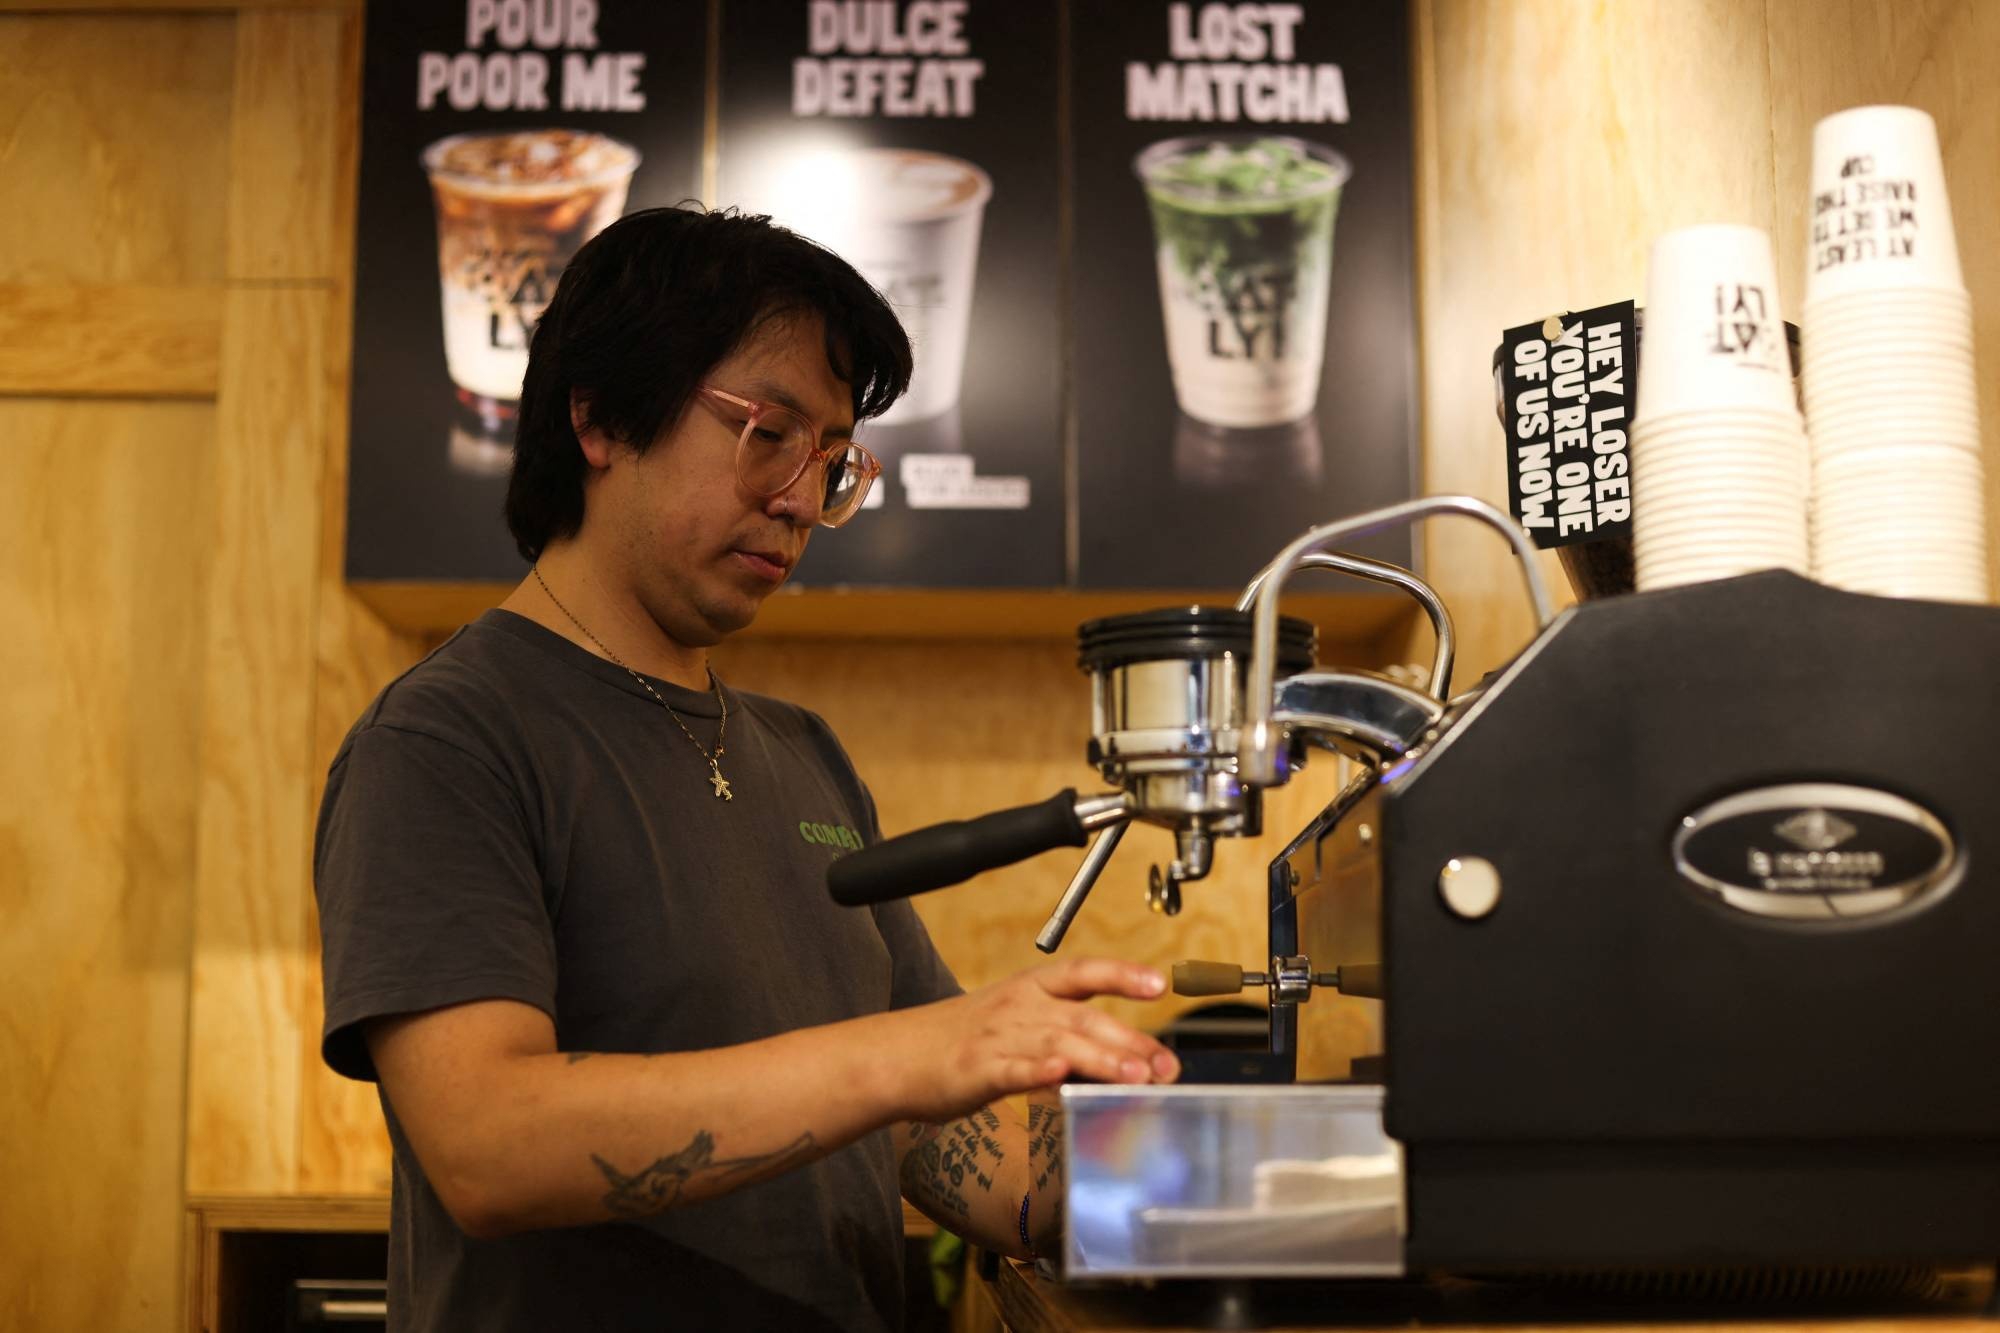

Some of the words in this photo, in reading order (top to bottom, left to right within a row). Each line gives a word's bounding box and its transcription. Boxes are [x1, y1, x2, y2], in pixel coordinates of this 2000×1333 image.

[466, 0, 599, 48] POUR
[809, 0, 970, 54] DULCE
[1169, 3, 1304, 60] LOST
[418, 53, 549, 110] POOR
[560, 53, 647, 112] ME
[792, 58, 985, 117] DEFEAT
[1125, 62, 1349, 122] MATCHA
[1514, 339, 1547, 382] OF
[1551, 320, 1591, 454] YOU'RE
[1587, 322, 1624, 396] HEY
[1516, 387, 1549, 439] US
[1518, 442, 1555, 537] NOW.
[1591, 406, 1631, 527] LOSER
[1556, 462, 1593, 537] ONE
